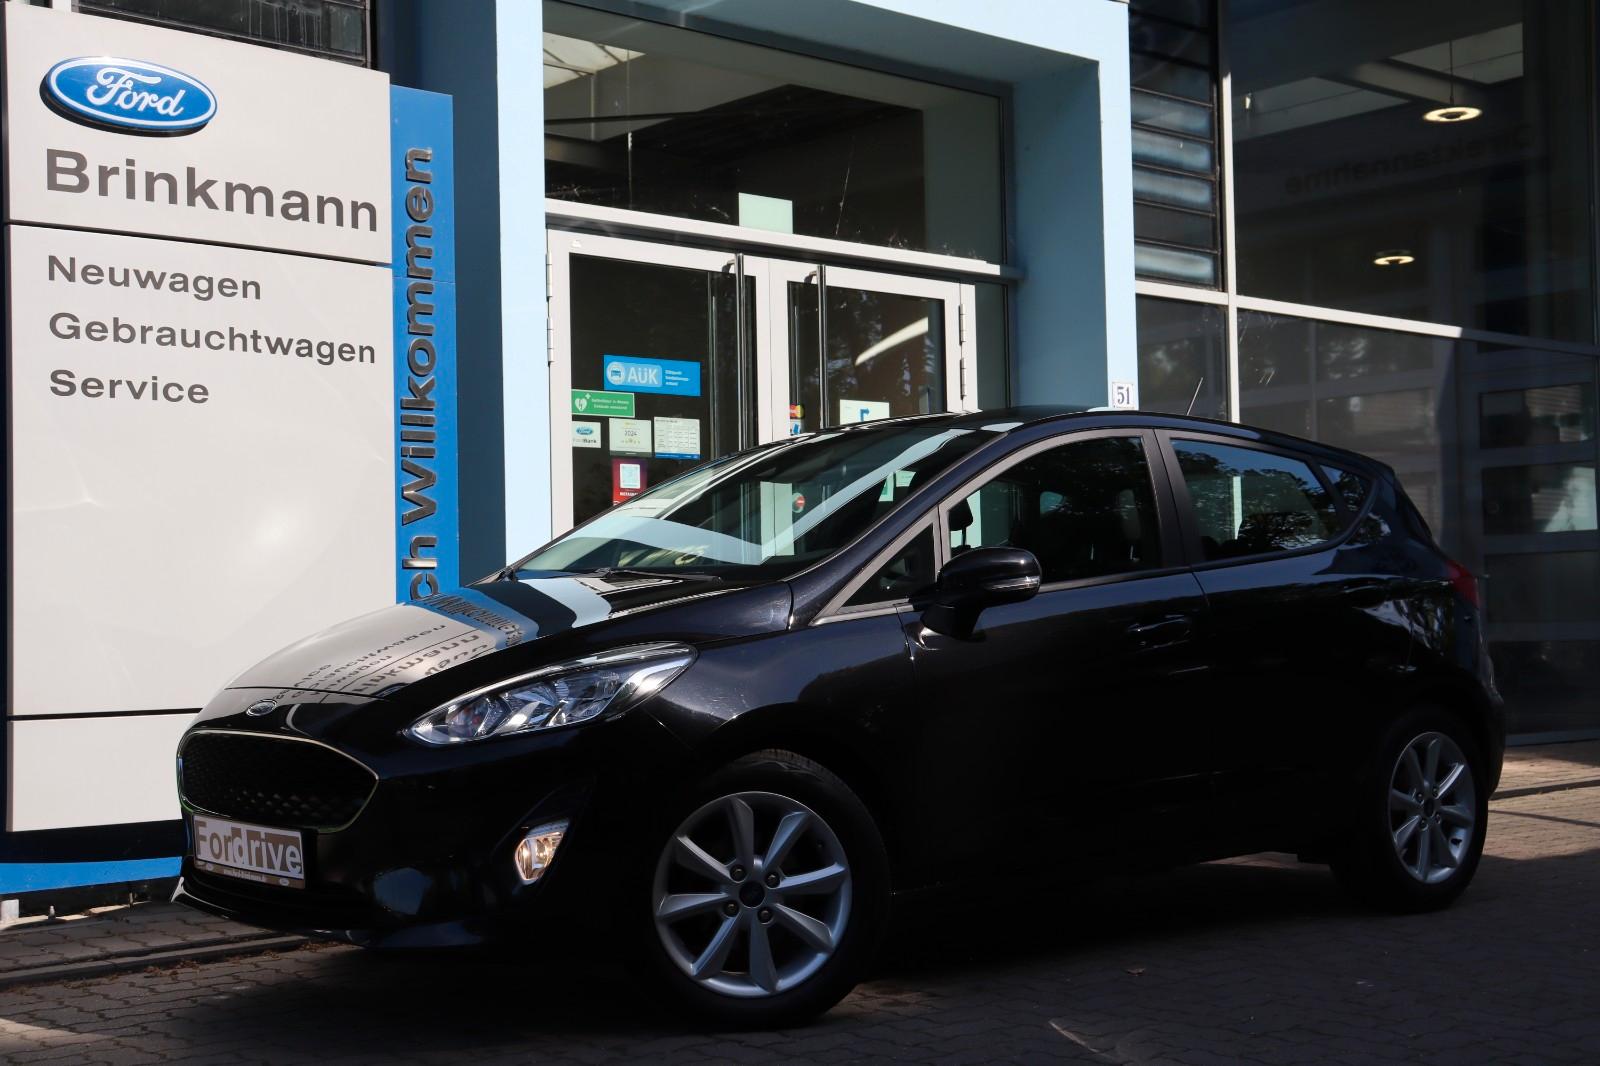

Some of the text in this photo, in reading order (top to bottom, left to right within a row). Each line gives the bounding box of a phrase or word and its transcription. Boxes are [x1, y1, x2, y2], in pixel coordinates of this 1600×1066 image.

[86, 67, 186, 117] Ford
[47, 149, 376, 231] Brinkmann
[49, 256, 260, 301] Neuwagen
[50, 313, 374, 365] Gebrauchtwagen
[400, 144, 438, 526] Willkommen
[51, 370, 208, 403] Service
[628, 367, 658, 385] AÜK
[1116, 386, 1130, 405] 51
[195, 820, 302, 874] Fordrive
